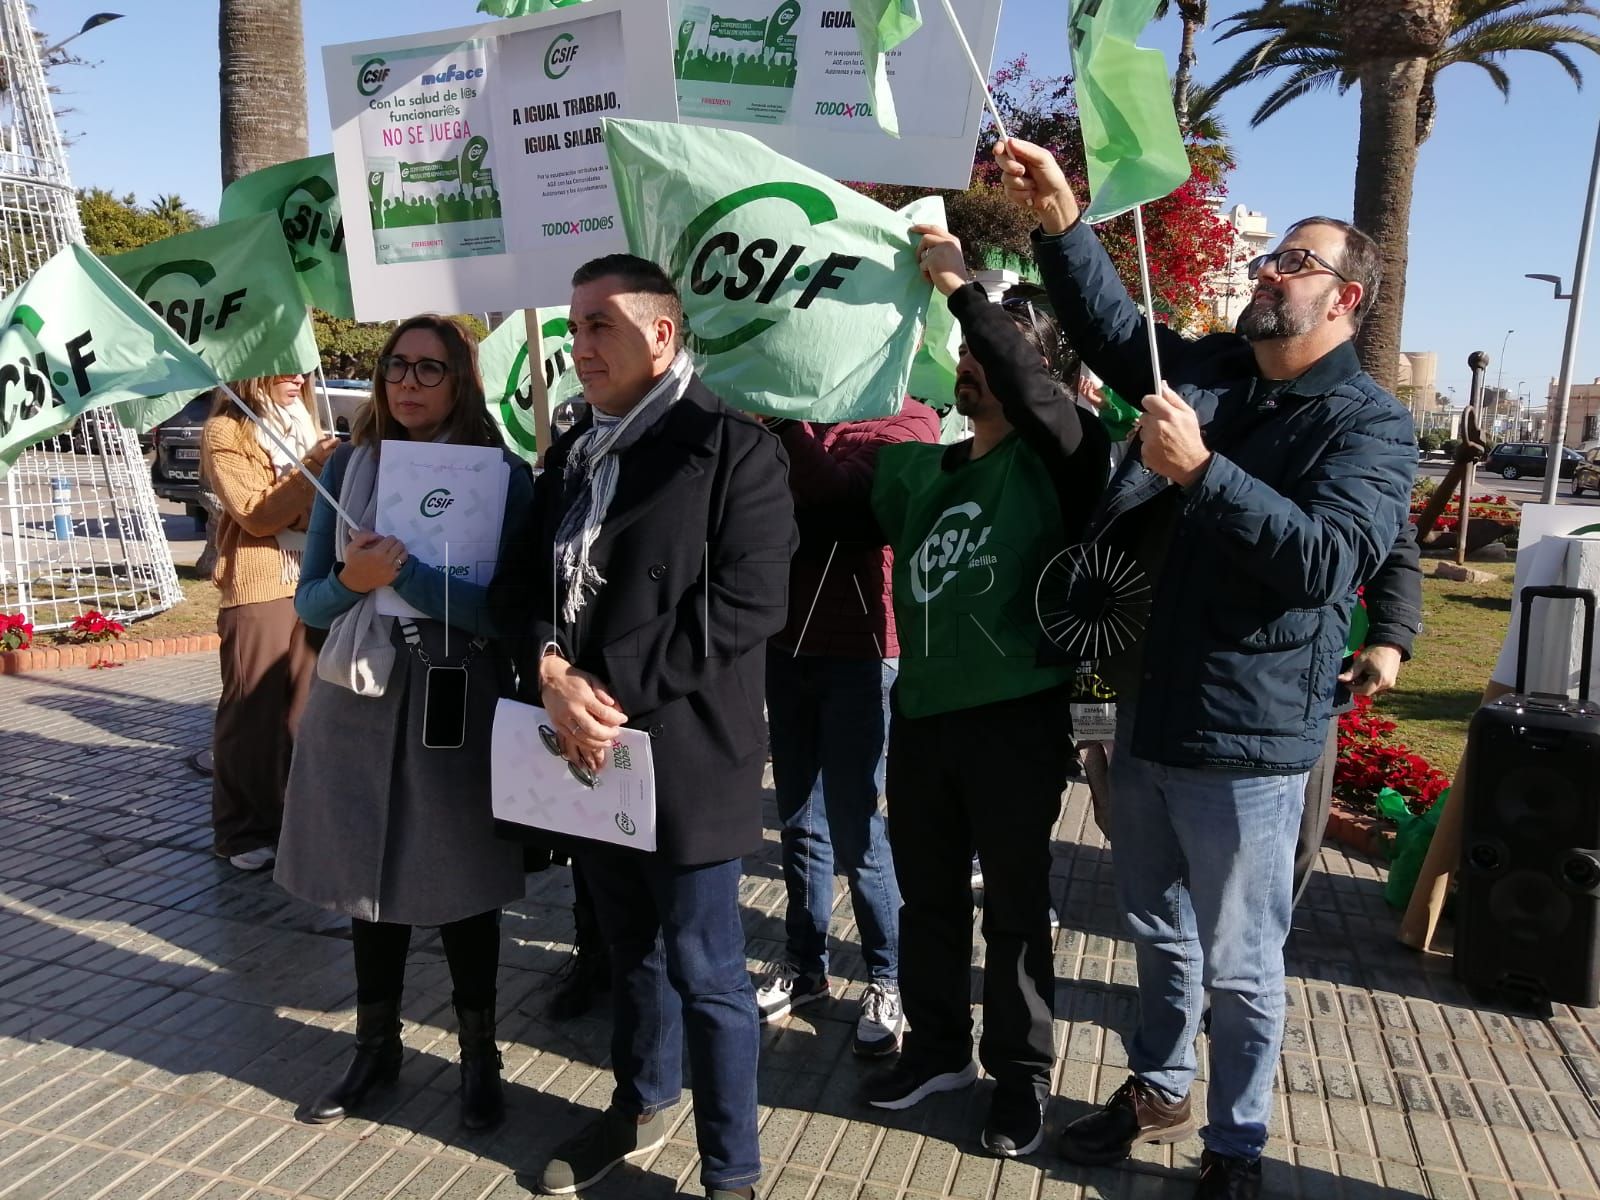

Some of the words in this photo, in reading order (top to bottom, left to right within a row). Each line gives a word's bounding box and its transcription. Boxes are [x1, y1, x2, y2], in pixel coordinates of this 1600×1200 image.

[550, 45, 579, 65] CSIF
[363, 68, 390, 84] CSIF
[369, 99, 391, 110] Con
[394, 96, 406, 107] la
[409, 91, 440, 106] salud
[443, 89, 458, 102] de
[460, 87, 477, 99] l@s
[513, 108, 522, 126] A
[524, 102, 560, 124] IGUAL
[562, 91, 621, 117] TRABAJO,
[389, 104, 461, 122] funcionari@s
[382, 128, 403, 147] NO
[408, 124, 424, 144] SE
[429, 119, 471, 142] JUEGA
[524, 133, 561, 154] IGUAL
[168, 470, 201, 480] POLIC
[426, 497, 455, 510] CSIF
